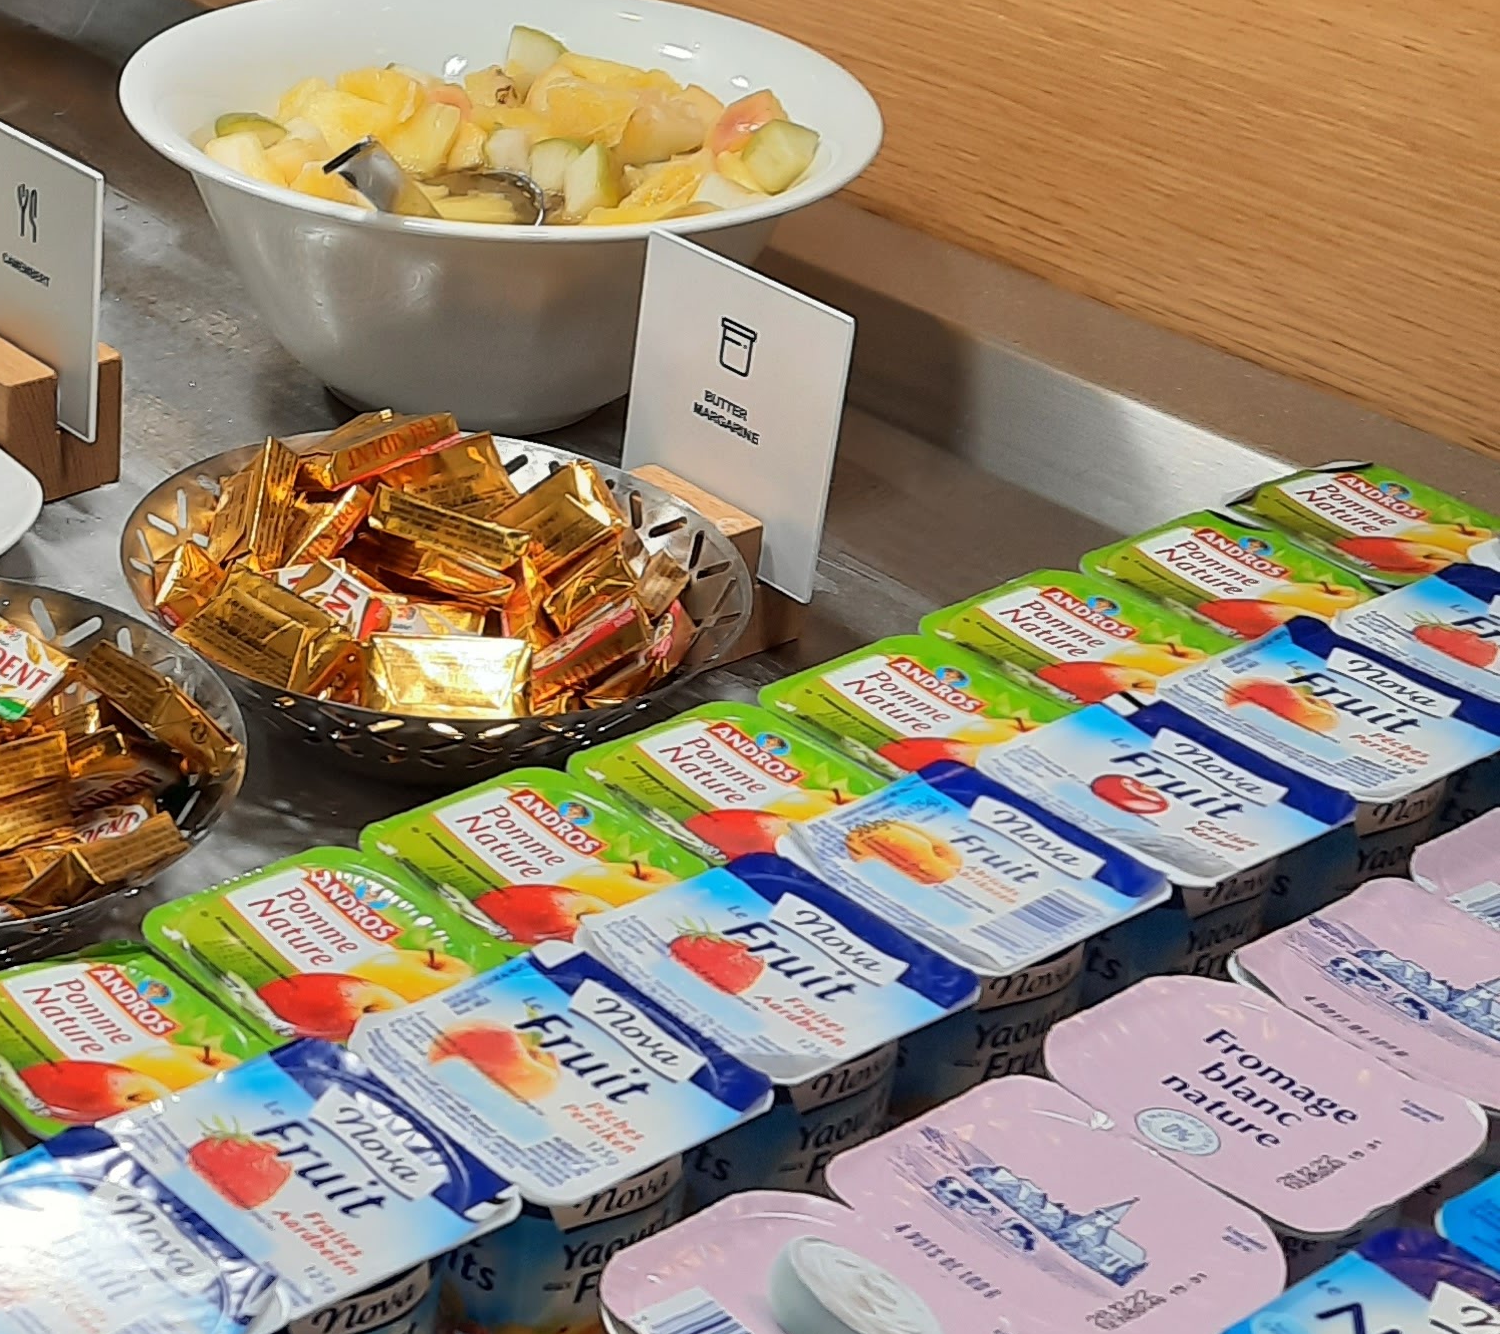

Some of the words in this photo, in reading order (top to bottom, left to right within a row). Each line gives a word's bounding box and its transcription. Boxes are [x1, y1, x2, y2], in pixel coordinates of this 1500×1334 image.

[693, 401, 761, 446] MARGARINE
[704, 389, 748, 422] BUTTER
[1295, 490, 1382, 534] Nature
[1316, 483, 1399, 528] Pomme
[1339, 474, 1424, 519] ANDROS
[1153, 549, 1244, 596] Nature
[1175, 539, 1260, 588] Pomme
[1197, 530, 1286, 578] ANDROS
[999, 609, 1089, 657] Nature
[1020, 601, 1106, 648] Pomme
[1043, 590, 1134, 638] ANDROS
[843, 680, 932, 732] Nature
[865, 670, 950, 723] Pomme
[889, 659, 983, 713] ANDROS
[1287, 672, 1421, 734] Fruit
[658, 746, 746, 804] Nature
[682, 736, 767, 794] Pomme
[712, 725, 800, 782] ANDROS
[1110, 752, 1245, 819] Fruit
[455, 816, 542, 878] Nature
[482, 804, 565, 867] Pomme
[514, 794, 602, 854] ANDROS
[950, 834, 1043, 885] Fruit
[248, 898, 334, 967] Nature
[277, 887, 358, 954] Pomme
[310, 870, 399, 941] ANDROS
[722, 922, 860, 1002] Fruit
[22, 988, 105, 1055] Nature
[54, 978, 134, 1044] Pomme
[90, 968, 176, 1035] ANDROS
[514, 1013, 649, 1105] Fruit
[1203, 1028, 1360, 1125] Fromage
[1160, 1074, 1282, 1149] nature
[1198, 1062, 1305, 1129] blanc
[253, 1120, 386, 1219] Fruit
